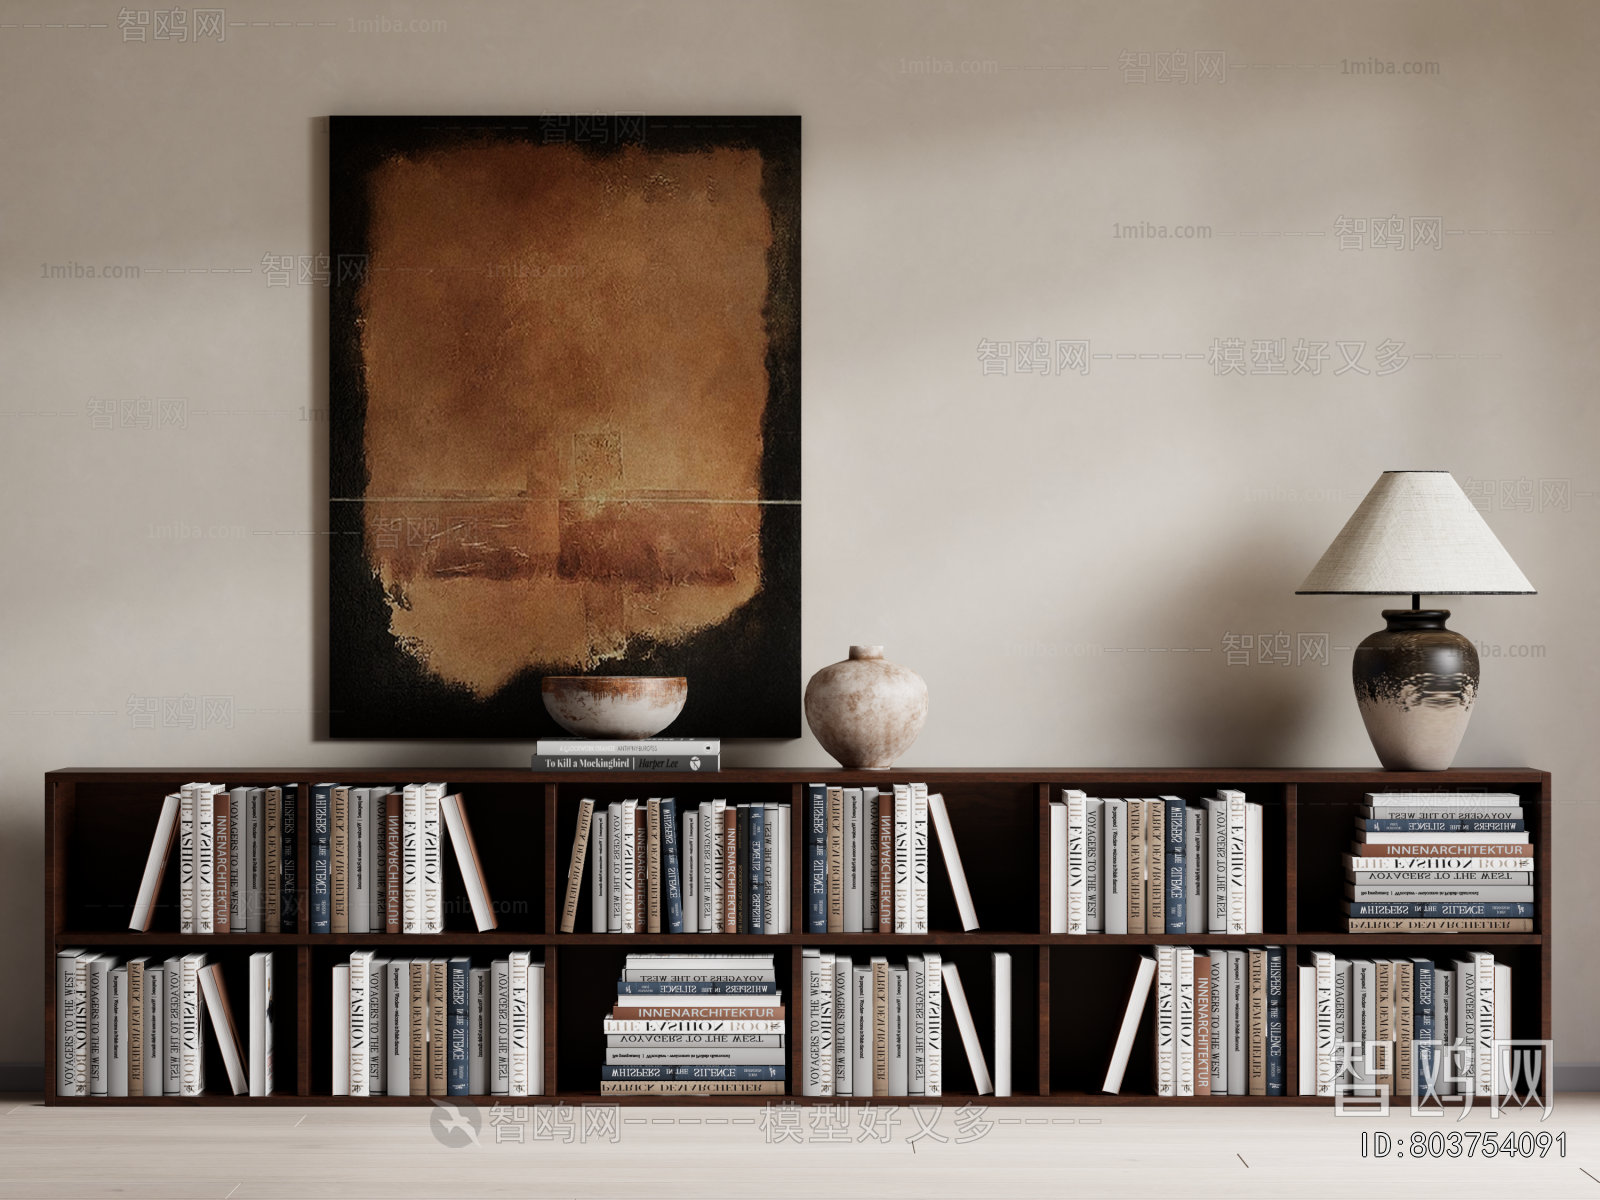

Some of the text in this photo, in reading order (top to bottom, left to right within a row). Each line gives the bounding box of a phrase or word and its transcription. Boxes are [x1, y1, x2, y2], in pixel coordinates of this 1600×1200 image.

[544, 758, 557, 768] To
[557, 758, 572, 768] Kill
[578, 758, 630, 770] Mockingbird
[638, 758, 664, 770] Harper
[664, 758, 679, 768] Lee
[217, 815, 227, 925] INNENARCHITEKTUR
[637, 828, 646, 926] INNENARCHITEKTUR
[728, 828, 736, 926] INNENARCHITEKTUR
[1387, 845, 1523, 855] INNENARCHITEKTUR
[65, 971, 74, 1087] VOYAGERS TO THE WEST
[638, 1008, 774, 1018] INNENARCHITEKTUR
[810, 971, 819, 1086] VOYAGERS TO THE WEST
[1198, 978, 1209, 1087] INNENARCHITEKTUR
